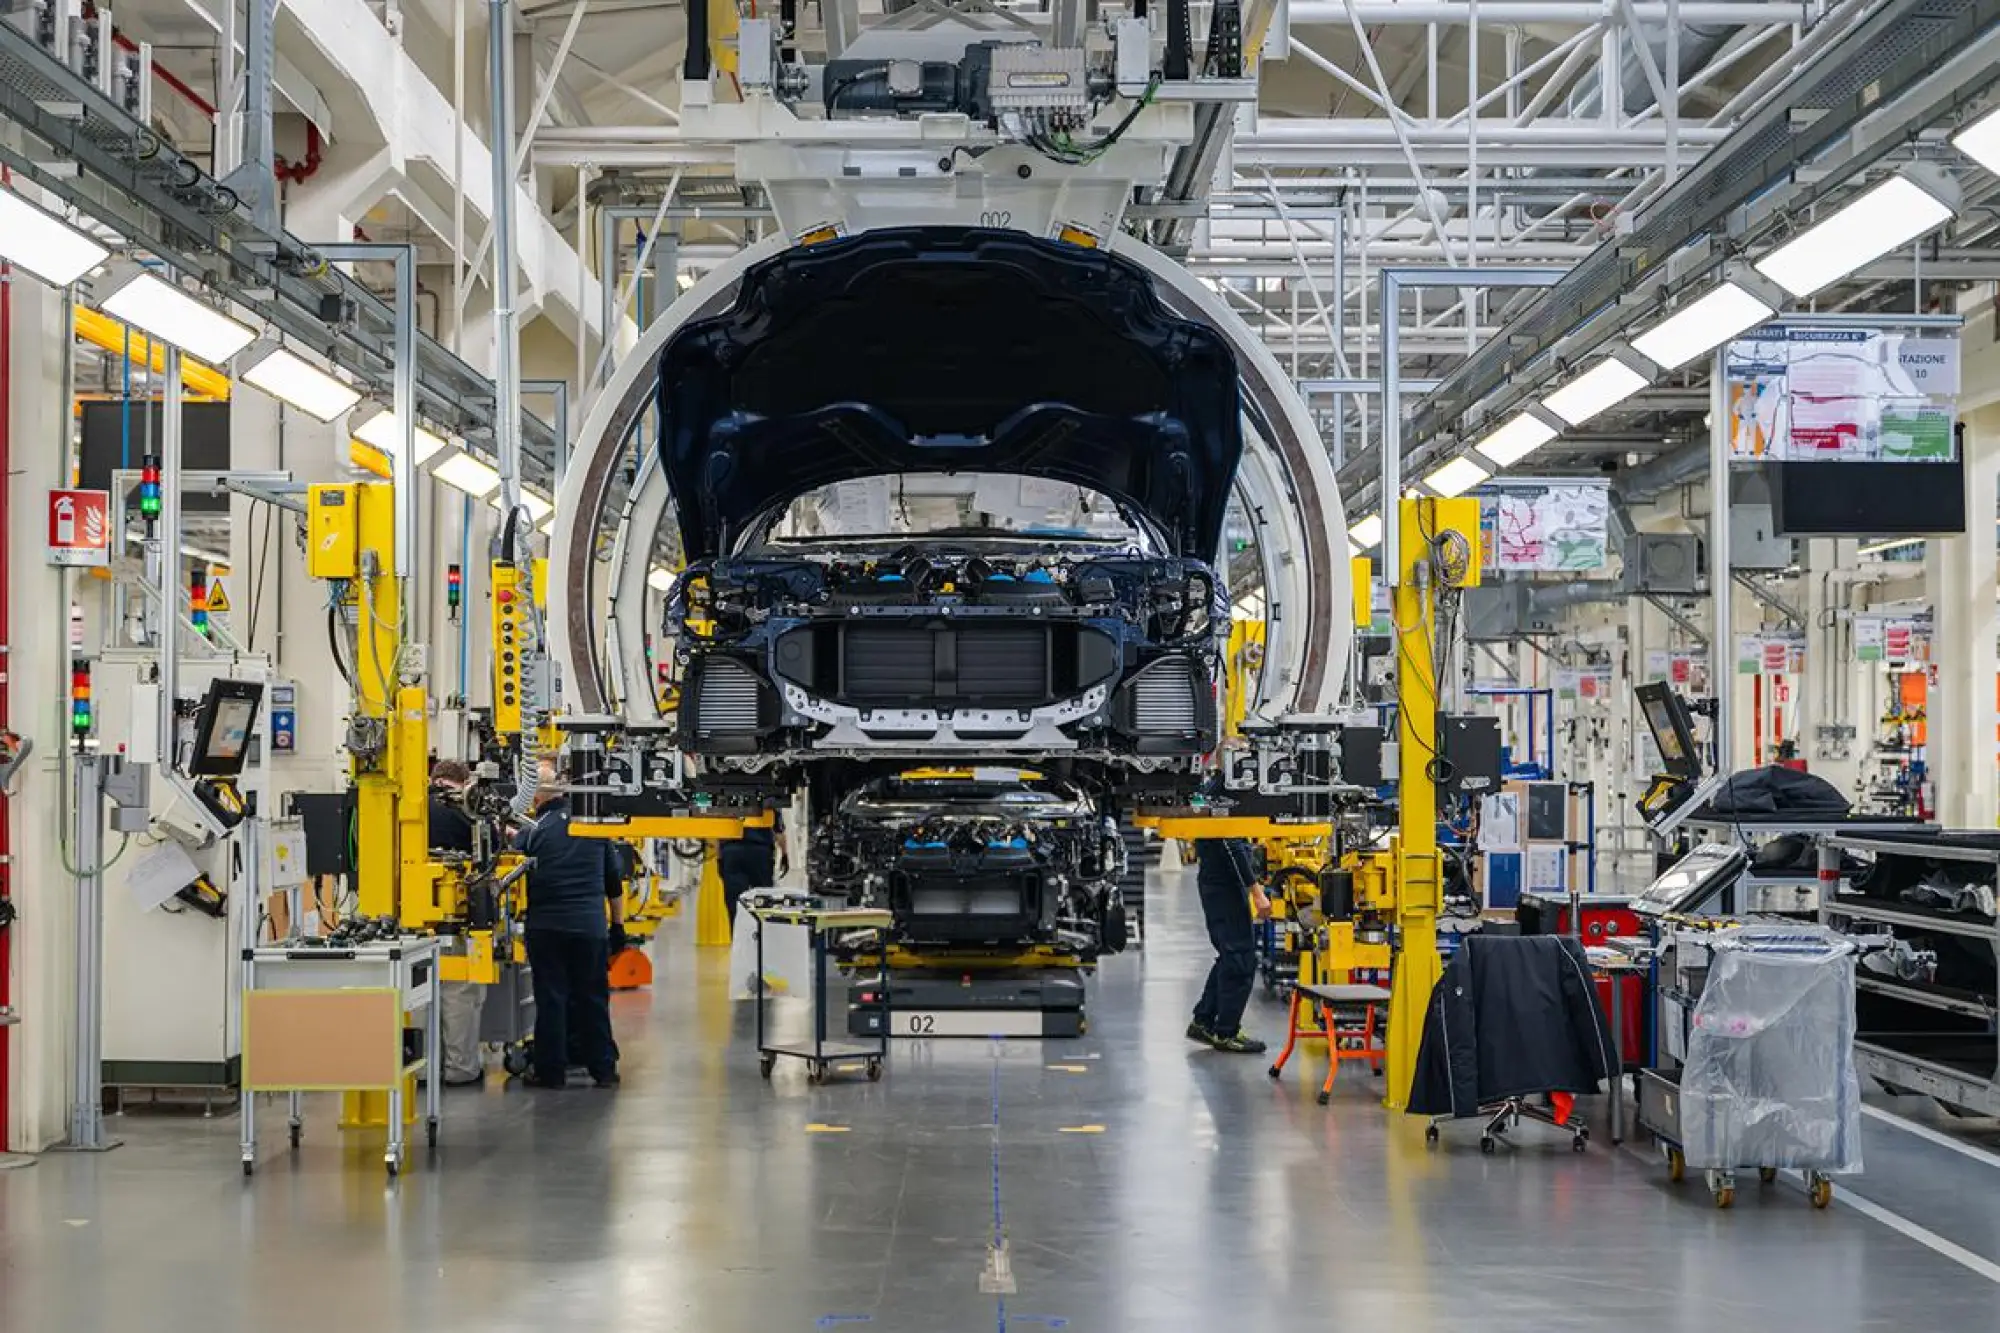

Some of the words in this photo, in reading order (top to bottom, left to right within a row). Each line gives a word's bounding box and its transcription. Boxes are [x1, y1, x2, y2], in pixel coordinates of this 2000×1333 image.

[980, 211, 1011, 229] 002
[1915, 369, 1927, 379] 10
[909, 1015, 935, 1034] 02
